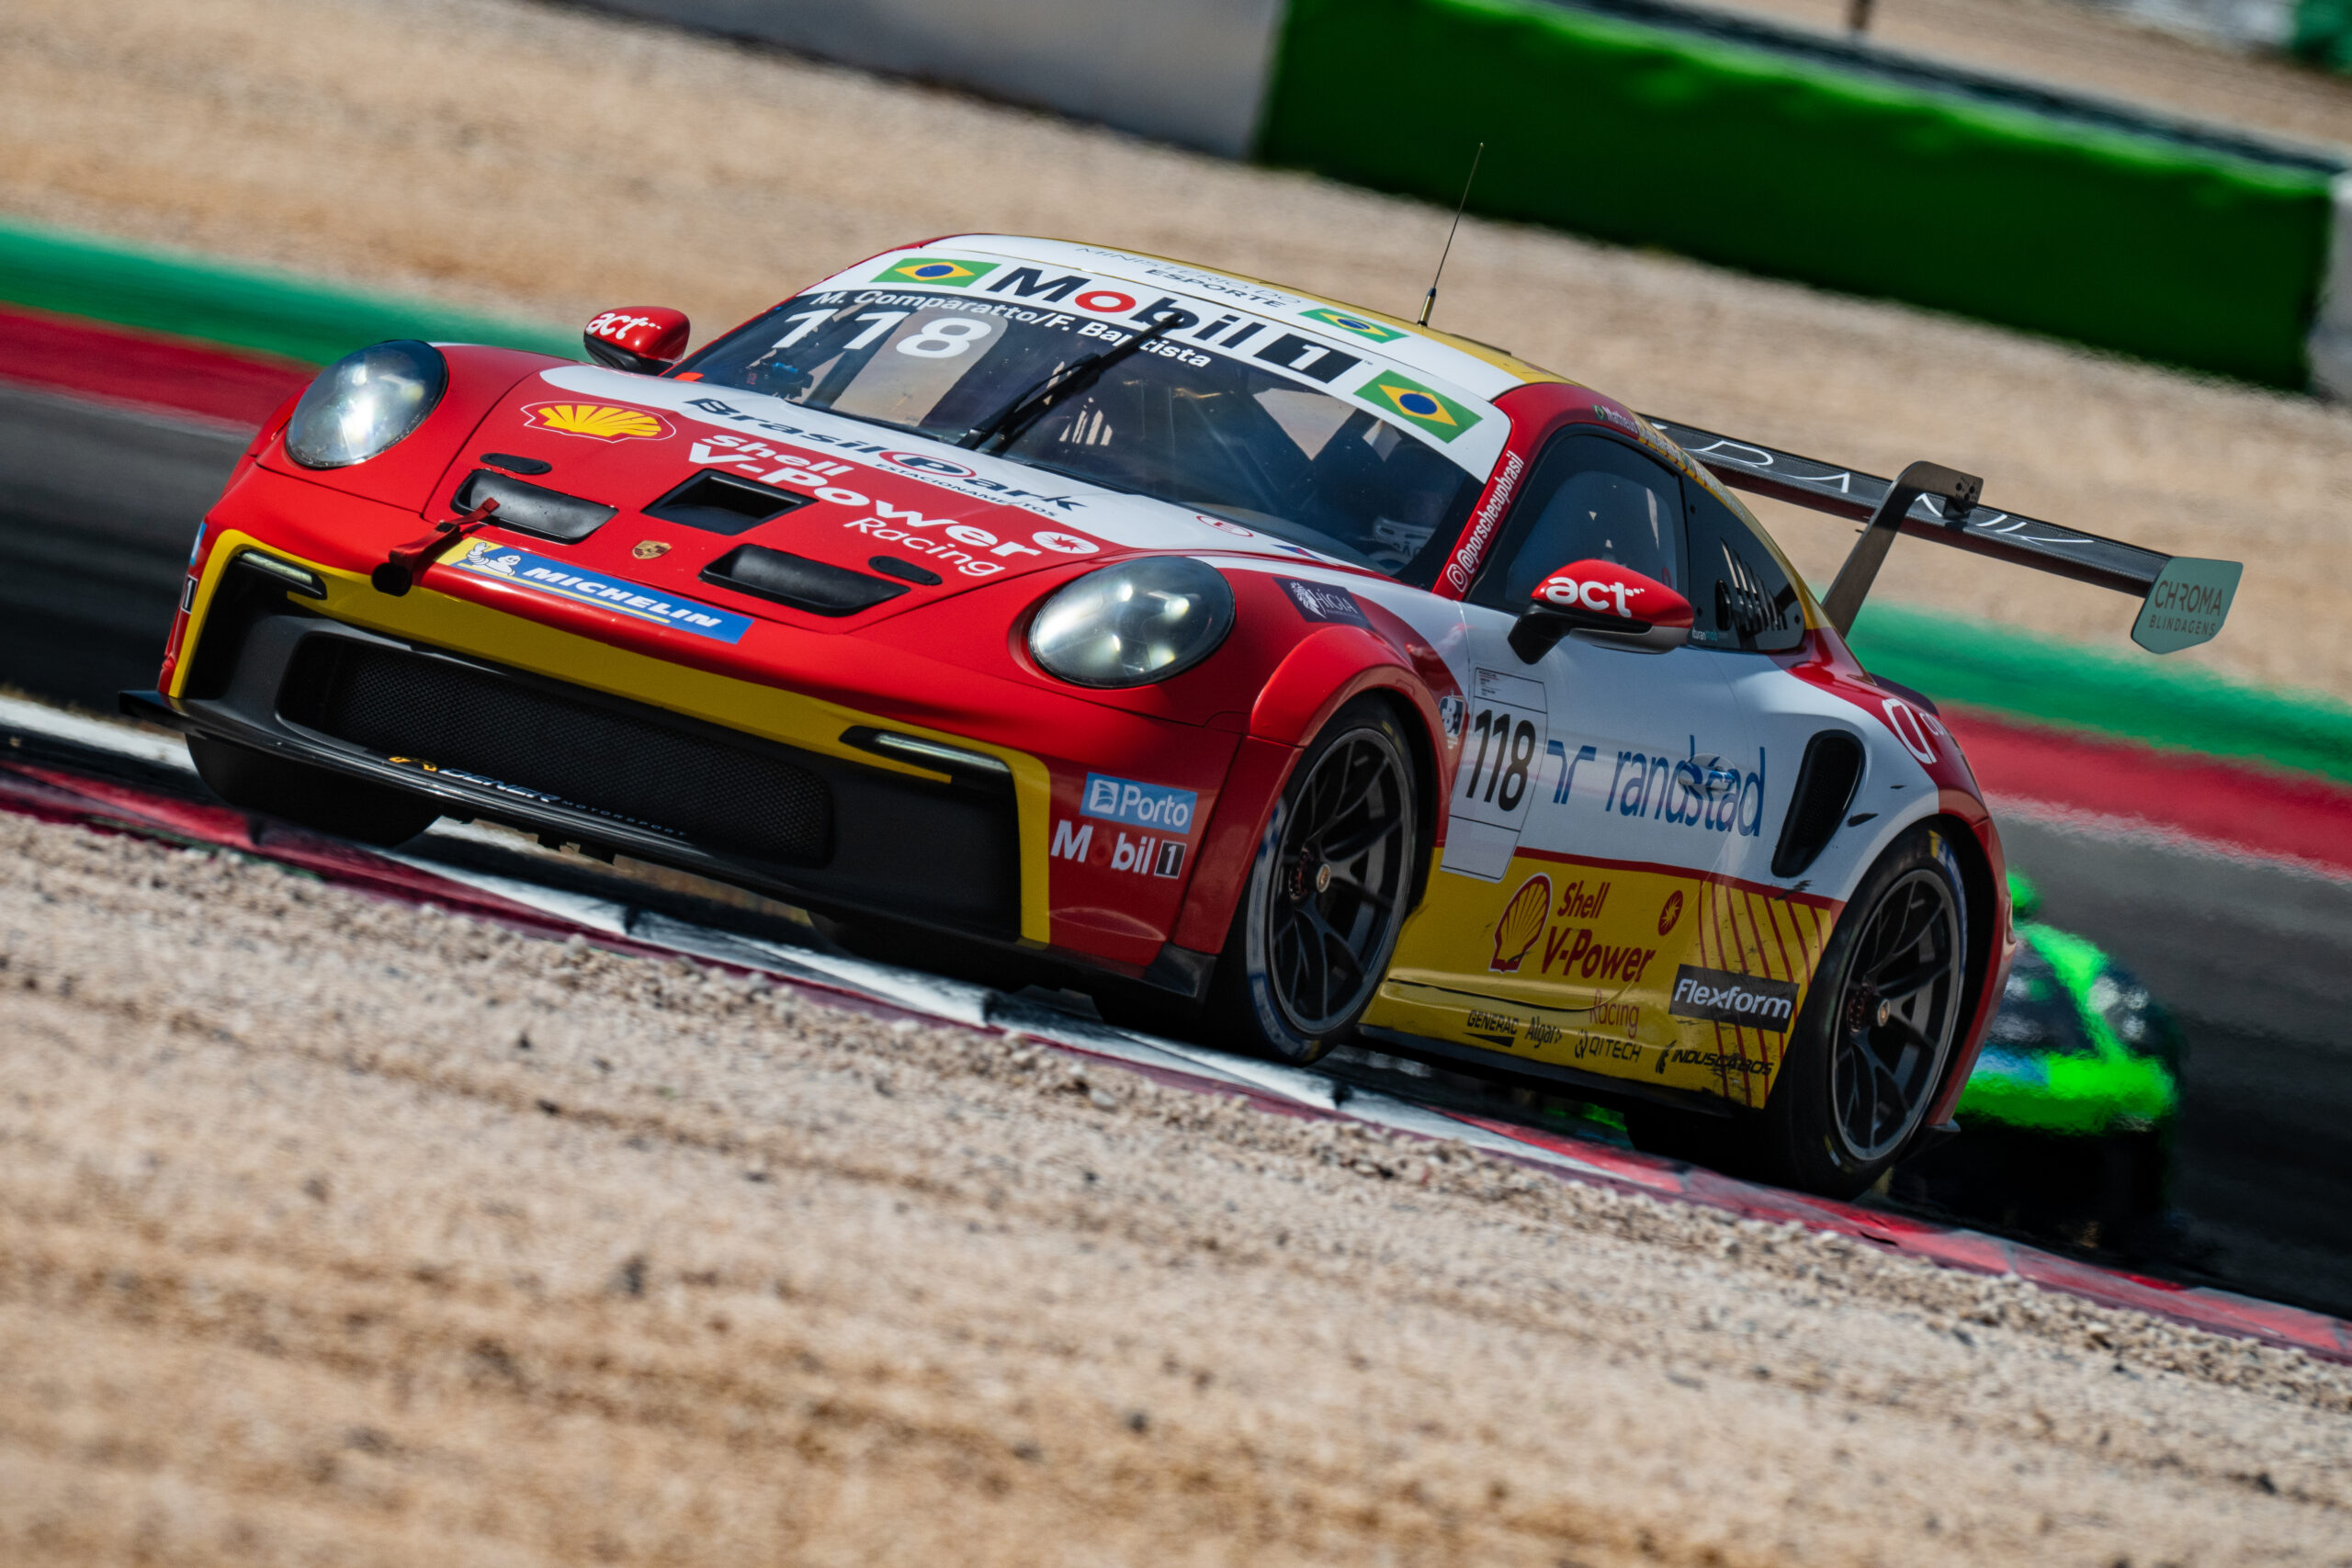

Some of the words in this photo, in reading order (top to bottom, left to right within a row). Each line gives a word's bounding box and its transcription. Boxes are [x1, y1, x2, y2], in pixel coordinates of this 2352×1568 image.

[810, 291, 852, 307] M.
[986, 266, 1268, 348] Mobil
[1145, 268, 1287, 309] ESPORTE
[772, 308, 992, 359] 118
[700, 434, 855, 477] Shell
[688, 441, 1043, 558] V-Power
[1455, 449, 1525, 574] @porschecupbrasil
[842, 515, 1006, 577] Racing
[522, 567, 723, 628] MICHELIN
[1545, 576, 1634, 618] act
[2154, 580, 2223, 616] CHROMA
[2148, 614, 2216, 637] BLINDAGENS
[1464, 708, 1536, 813] 118
[1118, 784, 1190, 827] Porto
[1604, 734, 1767, 838] randstad
[1556, 879, 1611, 919] Shell
[1540, 925, 1657, 984] V-Power
[1466, 1010, 1520, 1035] GENERAC
[1589, 988, 1640, 1039] Racing
[1673, 977, 1794, 1021] Flexform
